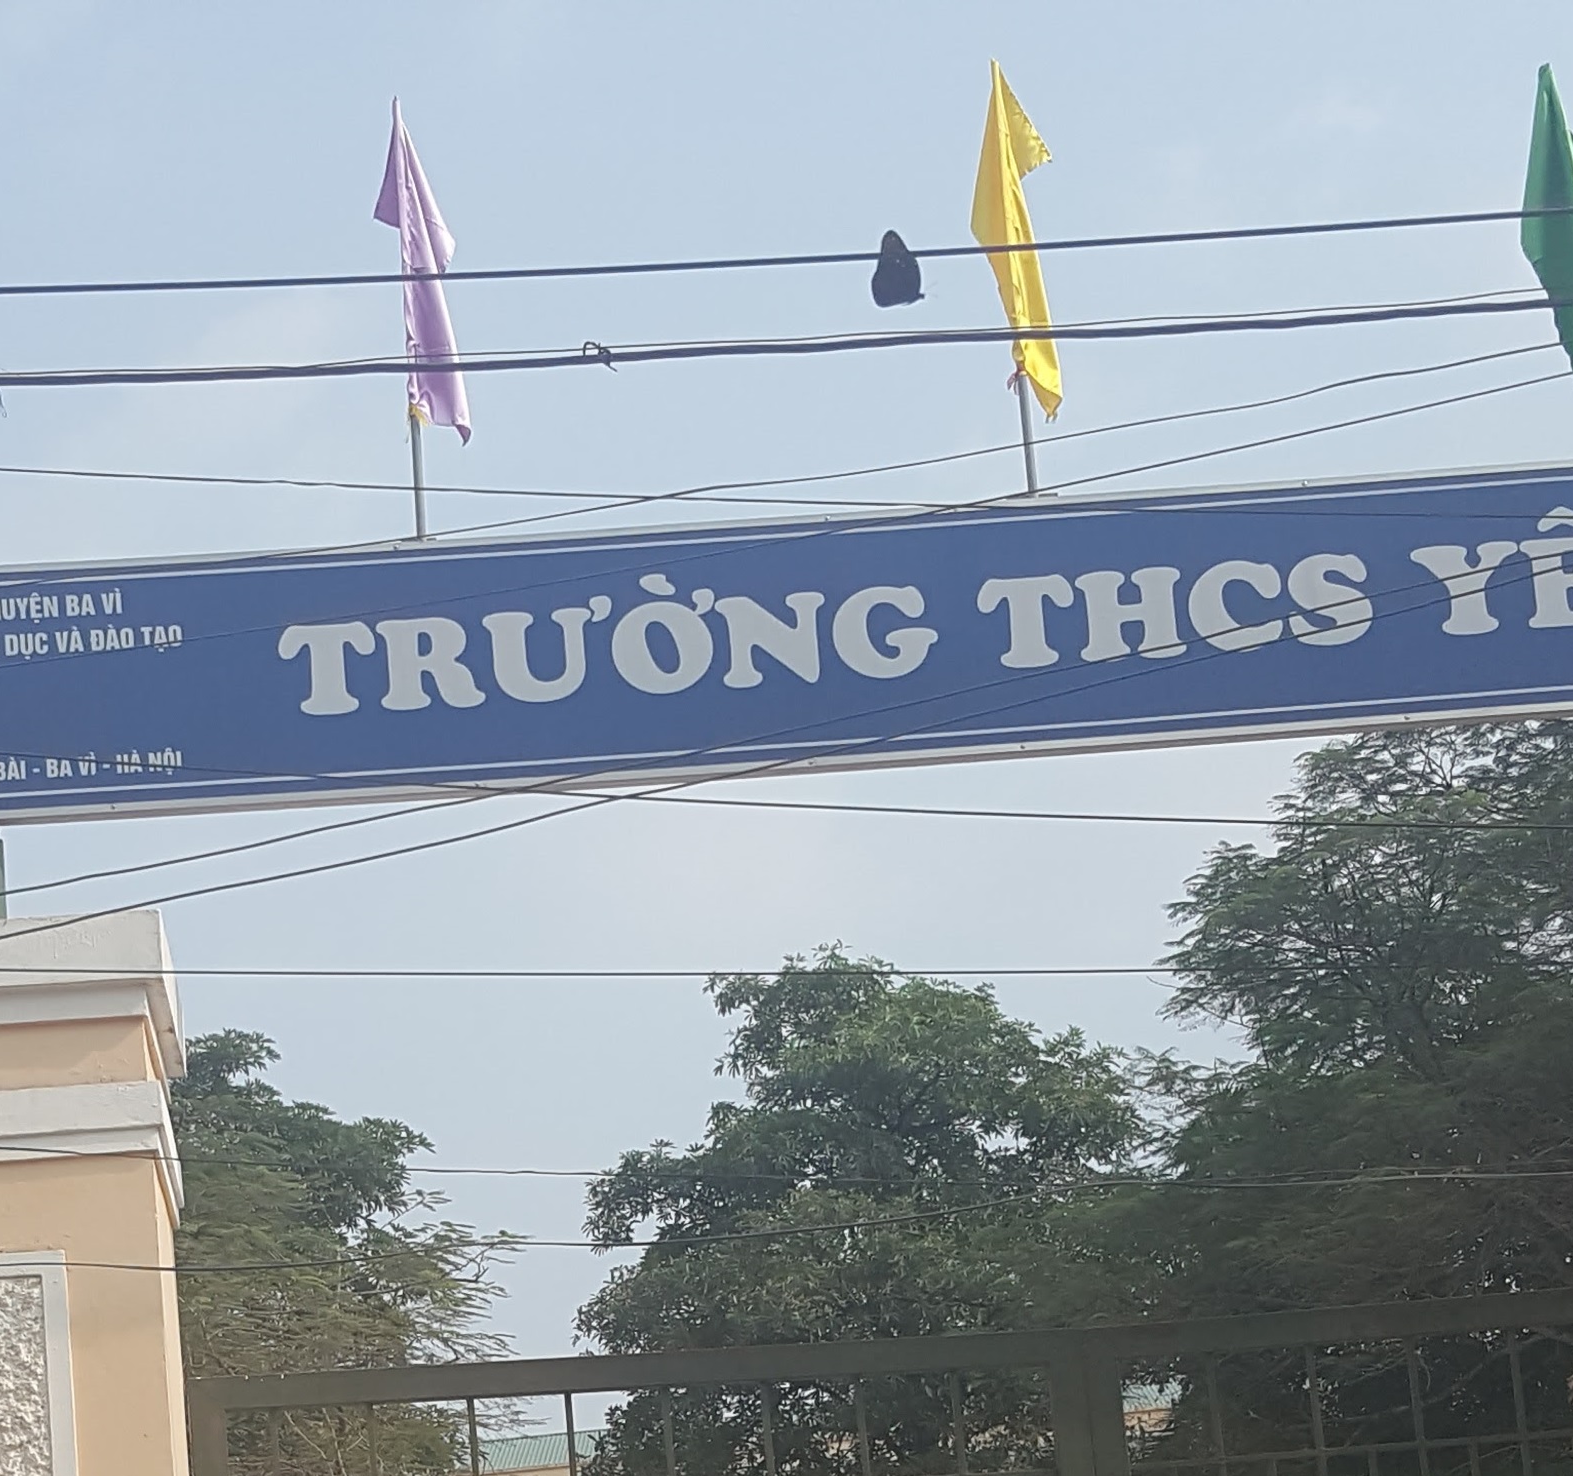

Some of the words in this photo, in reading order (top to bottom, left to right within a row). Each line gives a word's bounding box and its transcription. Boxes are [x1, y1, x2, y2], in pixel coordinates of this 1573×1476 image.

[65, 593, 96, 617] BA
[100, 587, 123, 615] VÌ
[4, 631, 49, 660] DỤC
[55, 625, 84, 653] VÀ
[89, 624, 135, 652] ĐÀO
[140, 624, 183, 653] TẠO
[277, 573, 939, 717] TRƯỜNG
[976, 553, 1374, 669] THCS
[45, 758, 73, 779] BA
[77, 751, 97, 777] VÌ
[115, 750, 143, 775] HÀ
[147, 747, 183, 776] NỘI
